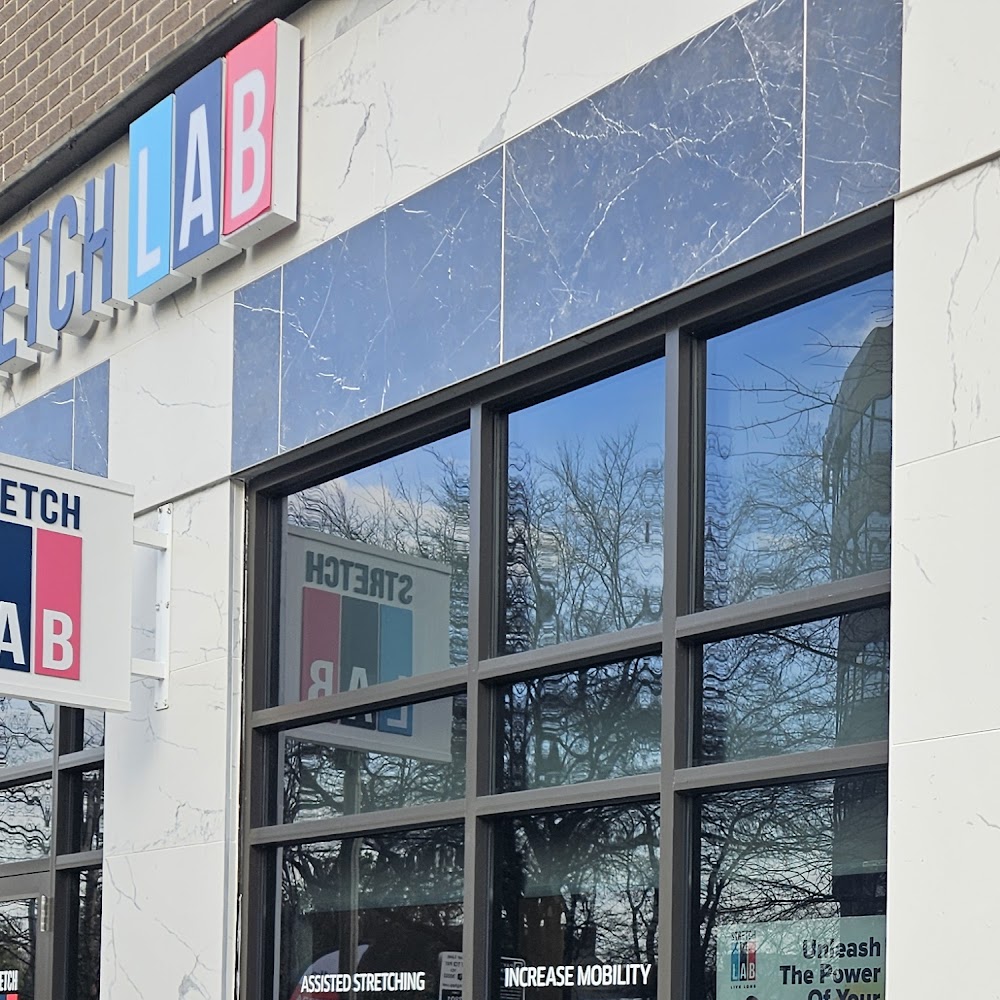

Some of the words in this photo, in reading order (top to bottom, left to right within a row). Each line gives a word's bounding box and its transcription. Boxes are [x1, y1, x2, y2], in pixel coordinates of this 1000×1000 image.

[137, 69, 266, 278] LAB
[803, 937, 881, 959] Unleash
[300, 973, 352, 993] ASSISTED
[353, 971, 426, 992] STRETCHING
[503, 965, 575, 988] INCREASE
[577, 963, 652, 987] MOBILITY
[732, 962, 756, 980] LAB
[780, 965, 814, 985] The
[820, 963, 881, 984] Power
